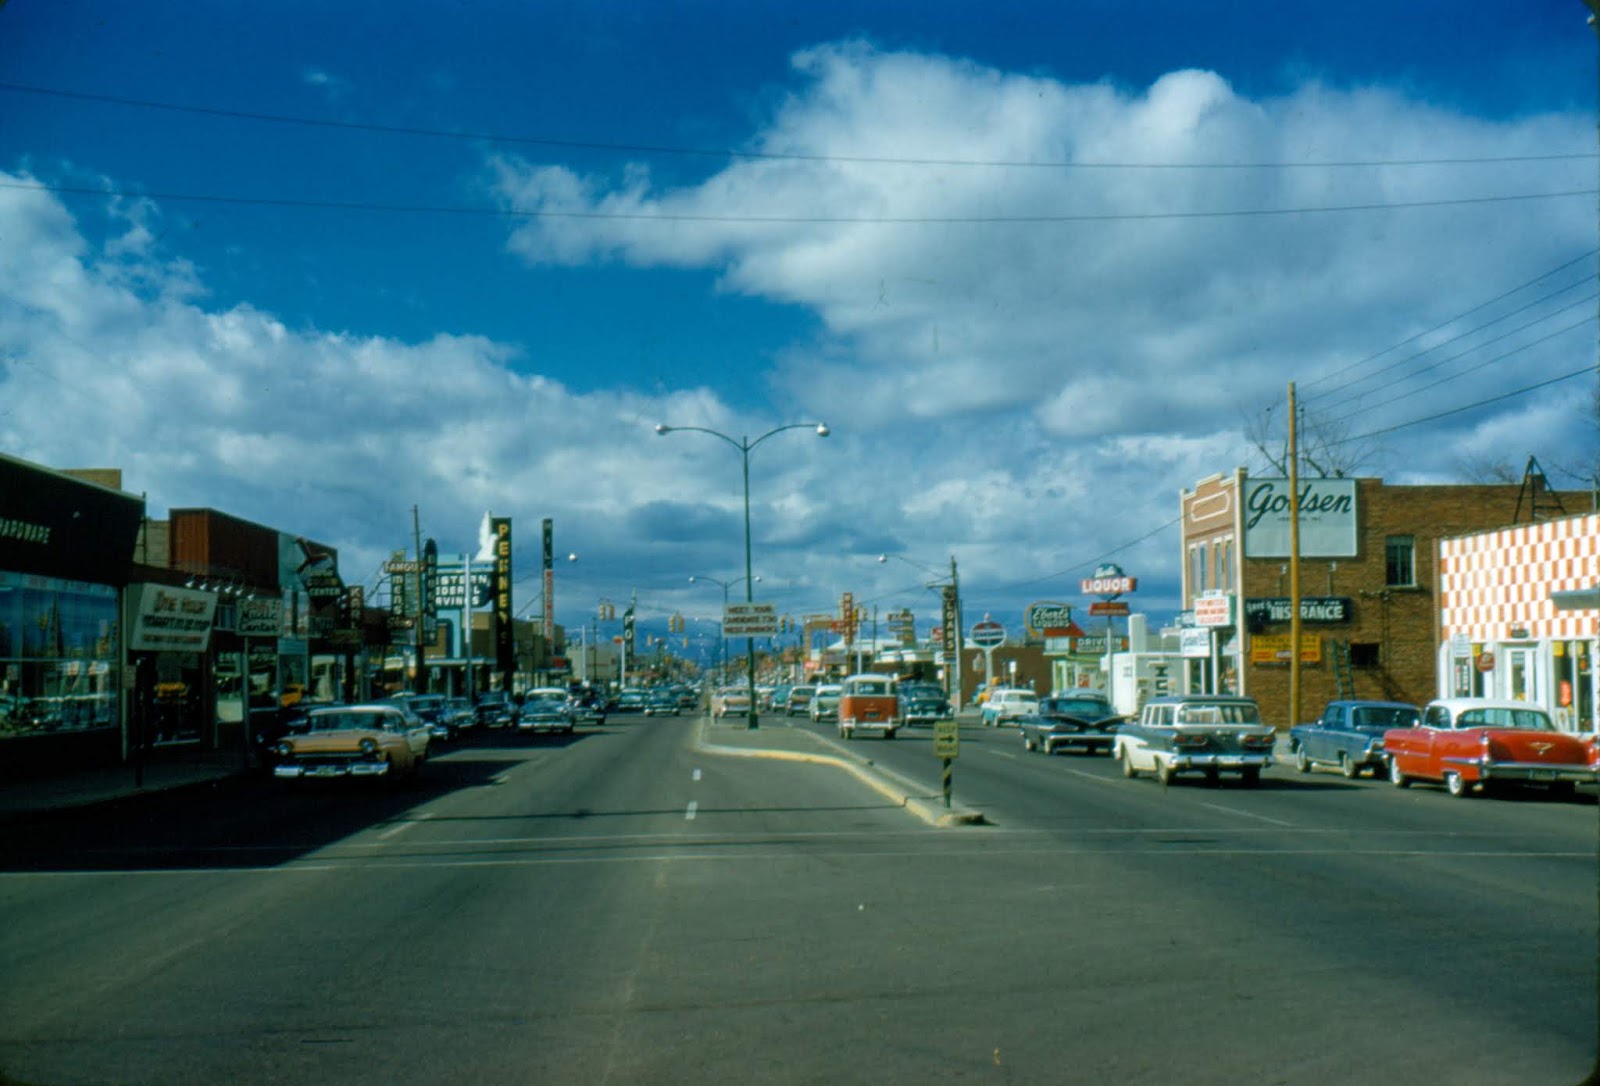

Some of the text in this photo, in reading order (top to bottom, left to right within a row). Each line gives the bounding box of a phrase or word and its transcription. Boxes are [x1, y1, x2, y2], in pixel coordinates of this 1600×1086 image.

[309, 587, 342, 597] CENTER
[1081, 578, 1131, 594] LIQUOR
[241, 610, 278, 621] Music
[1271, 605, 1344, 619] INSRANCE
[946, 601, 955, 649] LOANS
